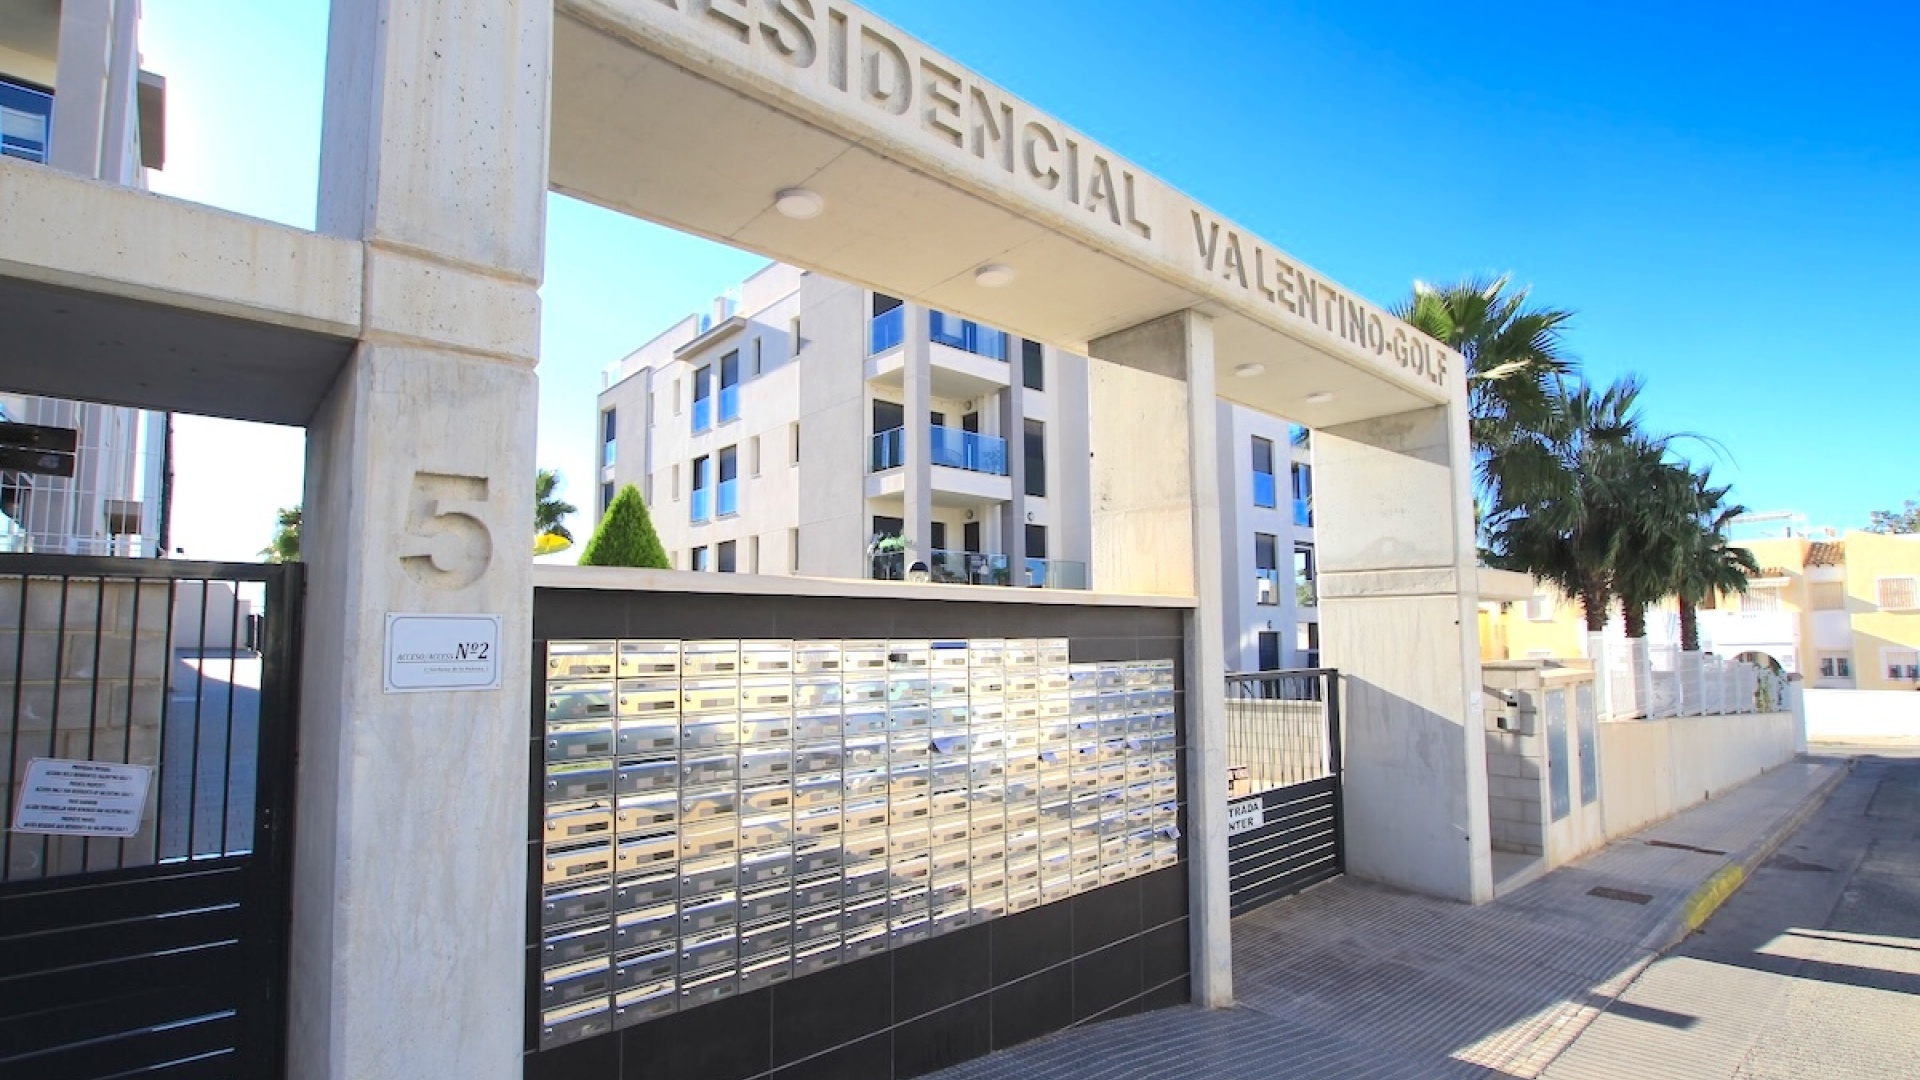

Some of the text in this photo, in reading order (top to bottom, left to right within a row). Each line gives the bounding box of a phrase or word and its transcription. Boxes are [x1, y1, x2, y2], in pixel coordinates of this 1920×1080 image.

[654, 0, 1447, 386] SIDENCIAL VALENTINO-GOLF
[399, 470, 493, 590] 5
[1228, 802, 1260, 818] TRADA
[1228, 816, 1254, 832] NTER
